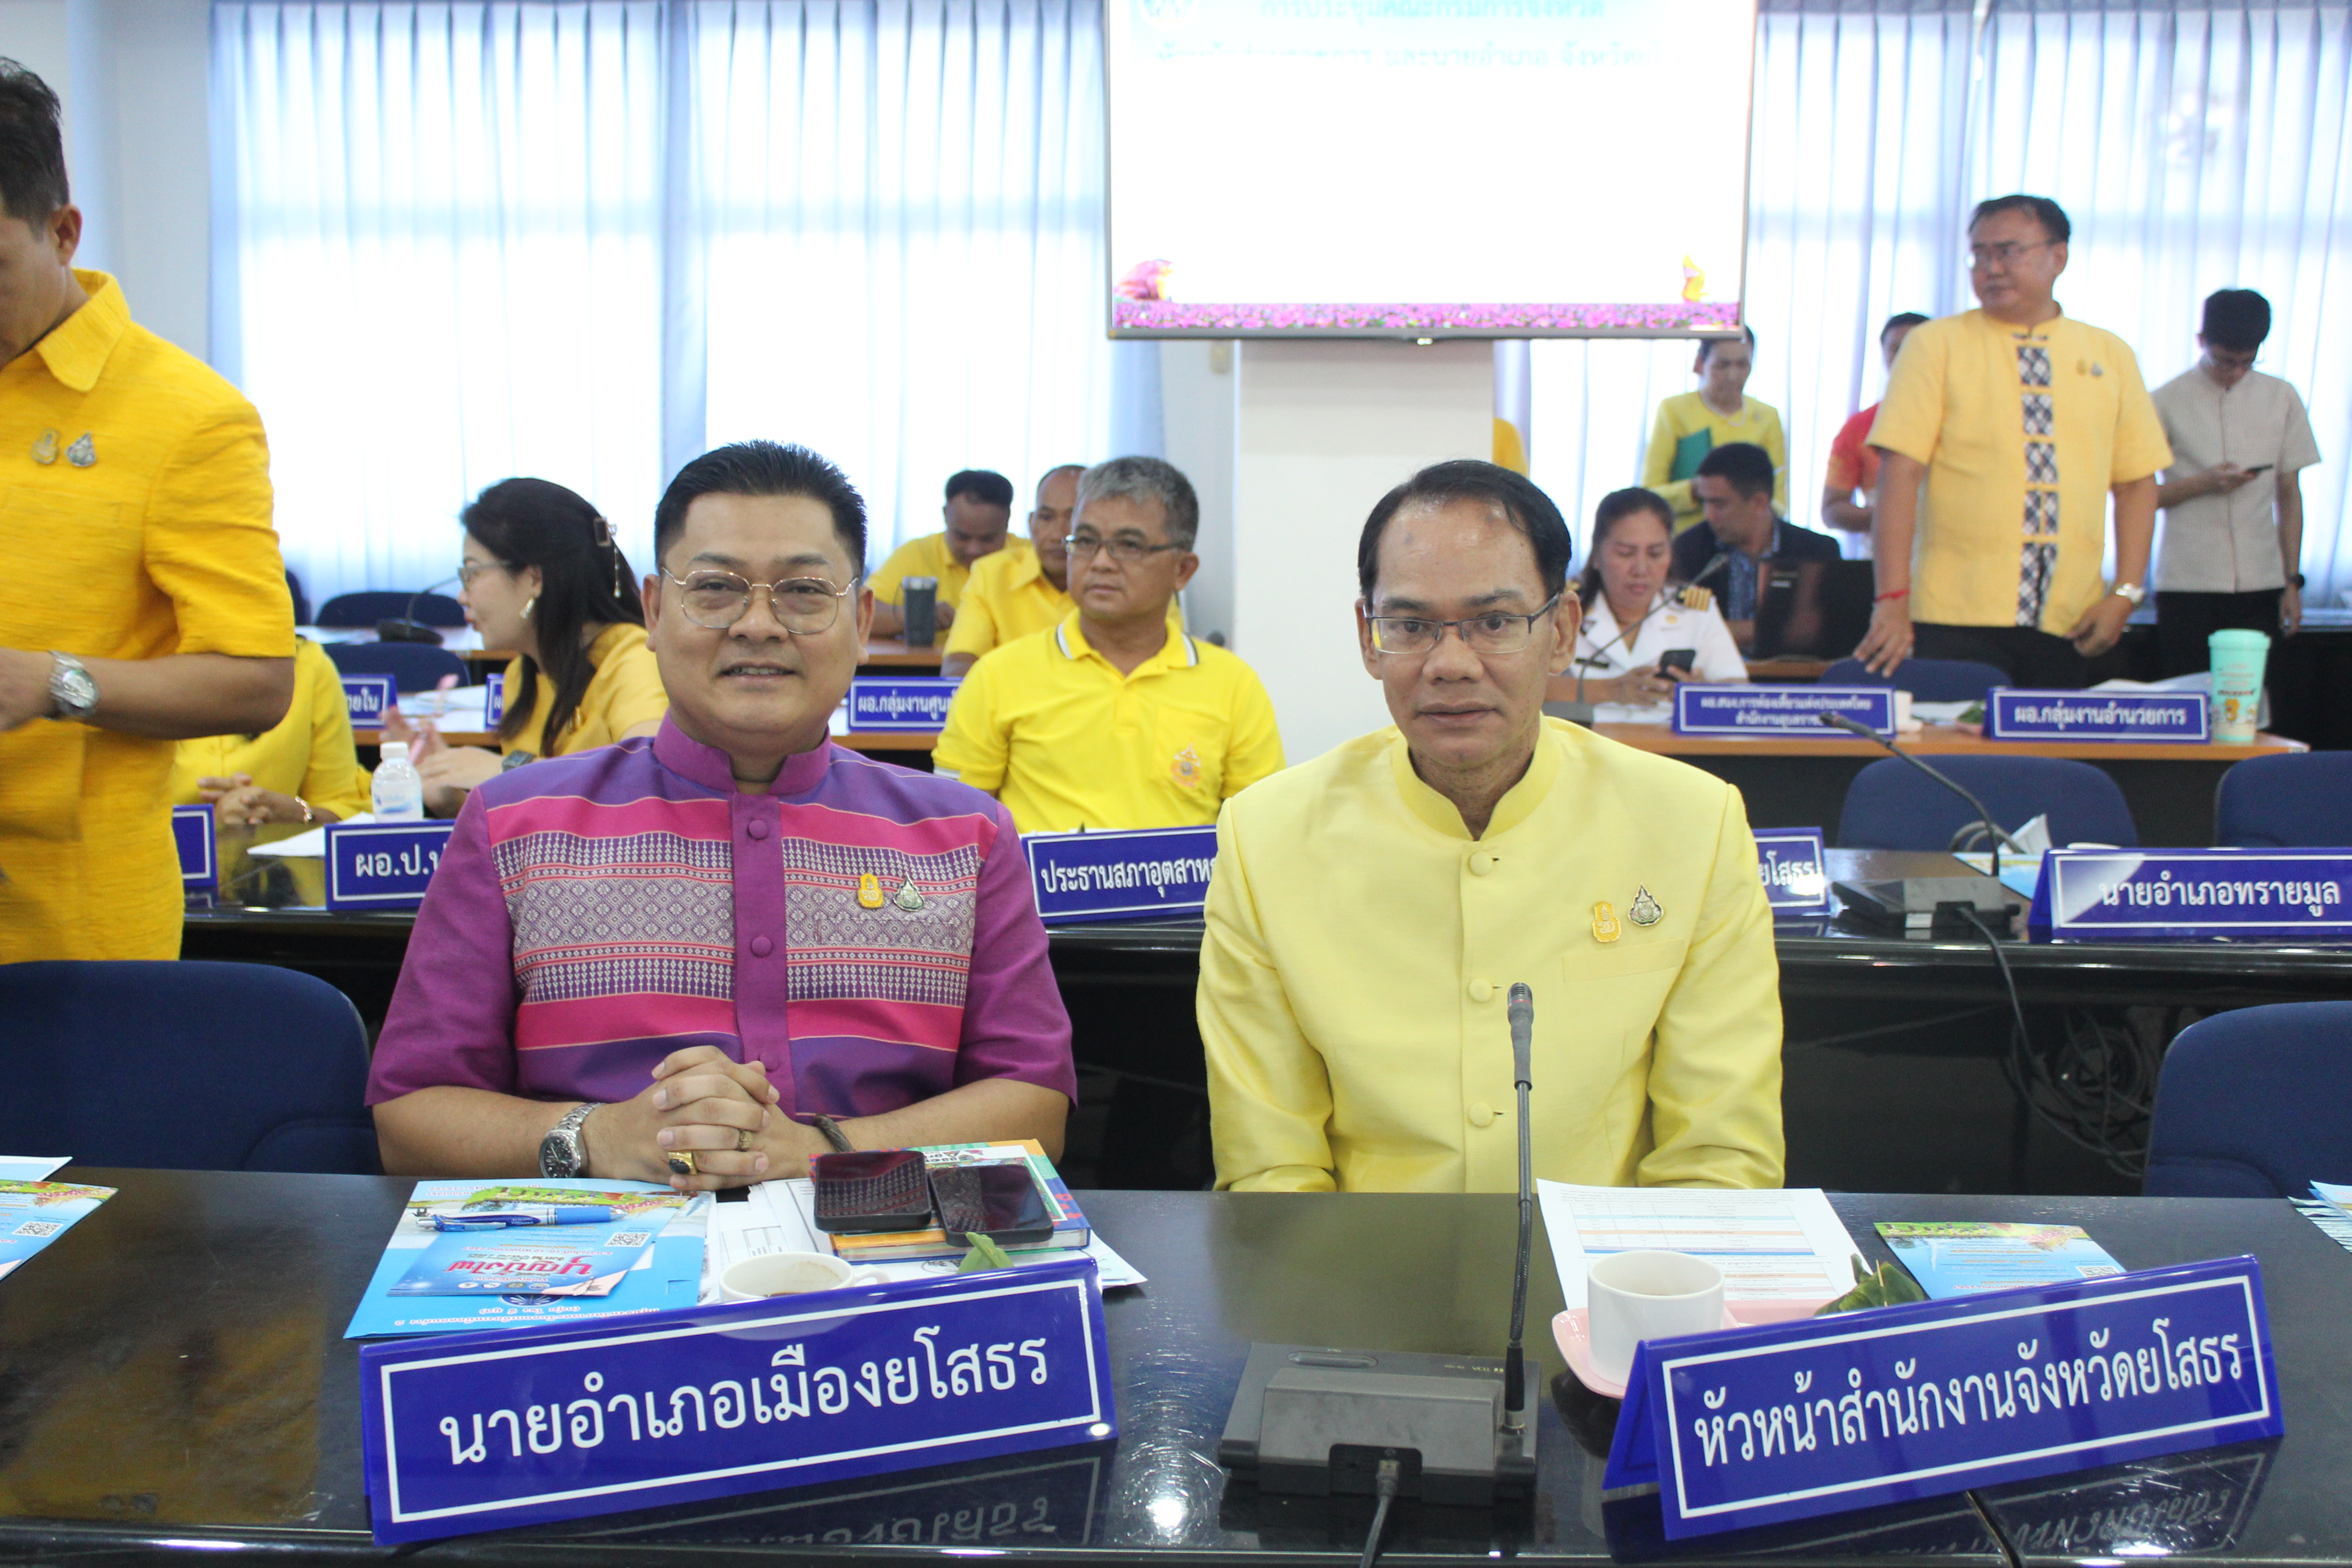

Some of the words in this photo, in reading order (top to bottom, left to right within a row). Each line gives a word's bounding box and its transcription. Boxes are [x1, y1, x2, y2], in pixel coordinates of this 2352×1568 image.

[1260, 0, 1604, 26] การประชุมคณะกรมการจงหวด
[2015, 700, 2187, 730] ผอ.กลุ่มงานอำนวยการ
[2099, 870, 2340, 916] นายอำเภอทรายมูล
[440, 1327, 1047, 1465] นายอำเภอเมืองยโสธร
[1694, 1318, 2243, 1468] หัวหน้าสำนักงานจังหวัดยโสธร
